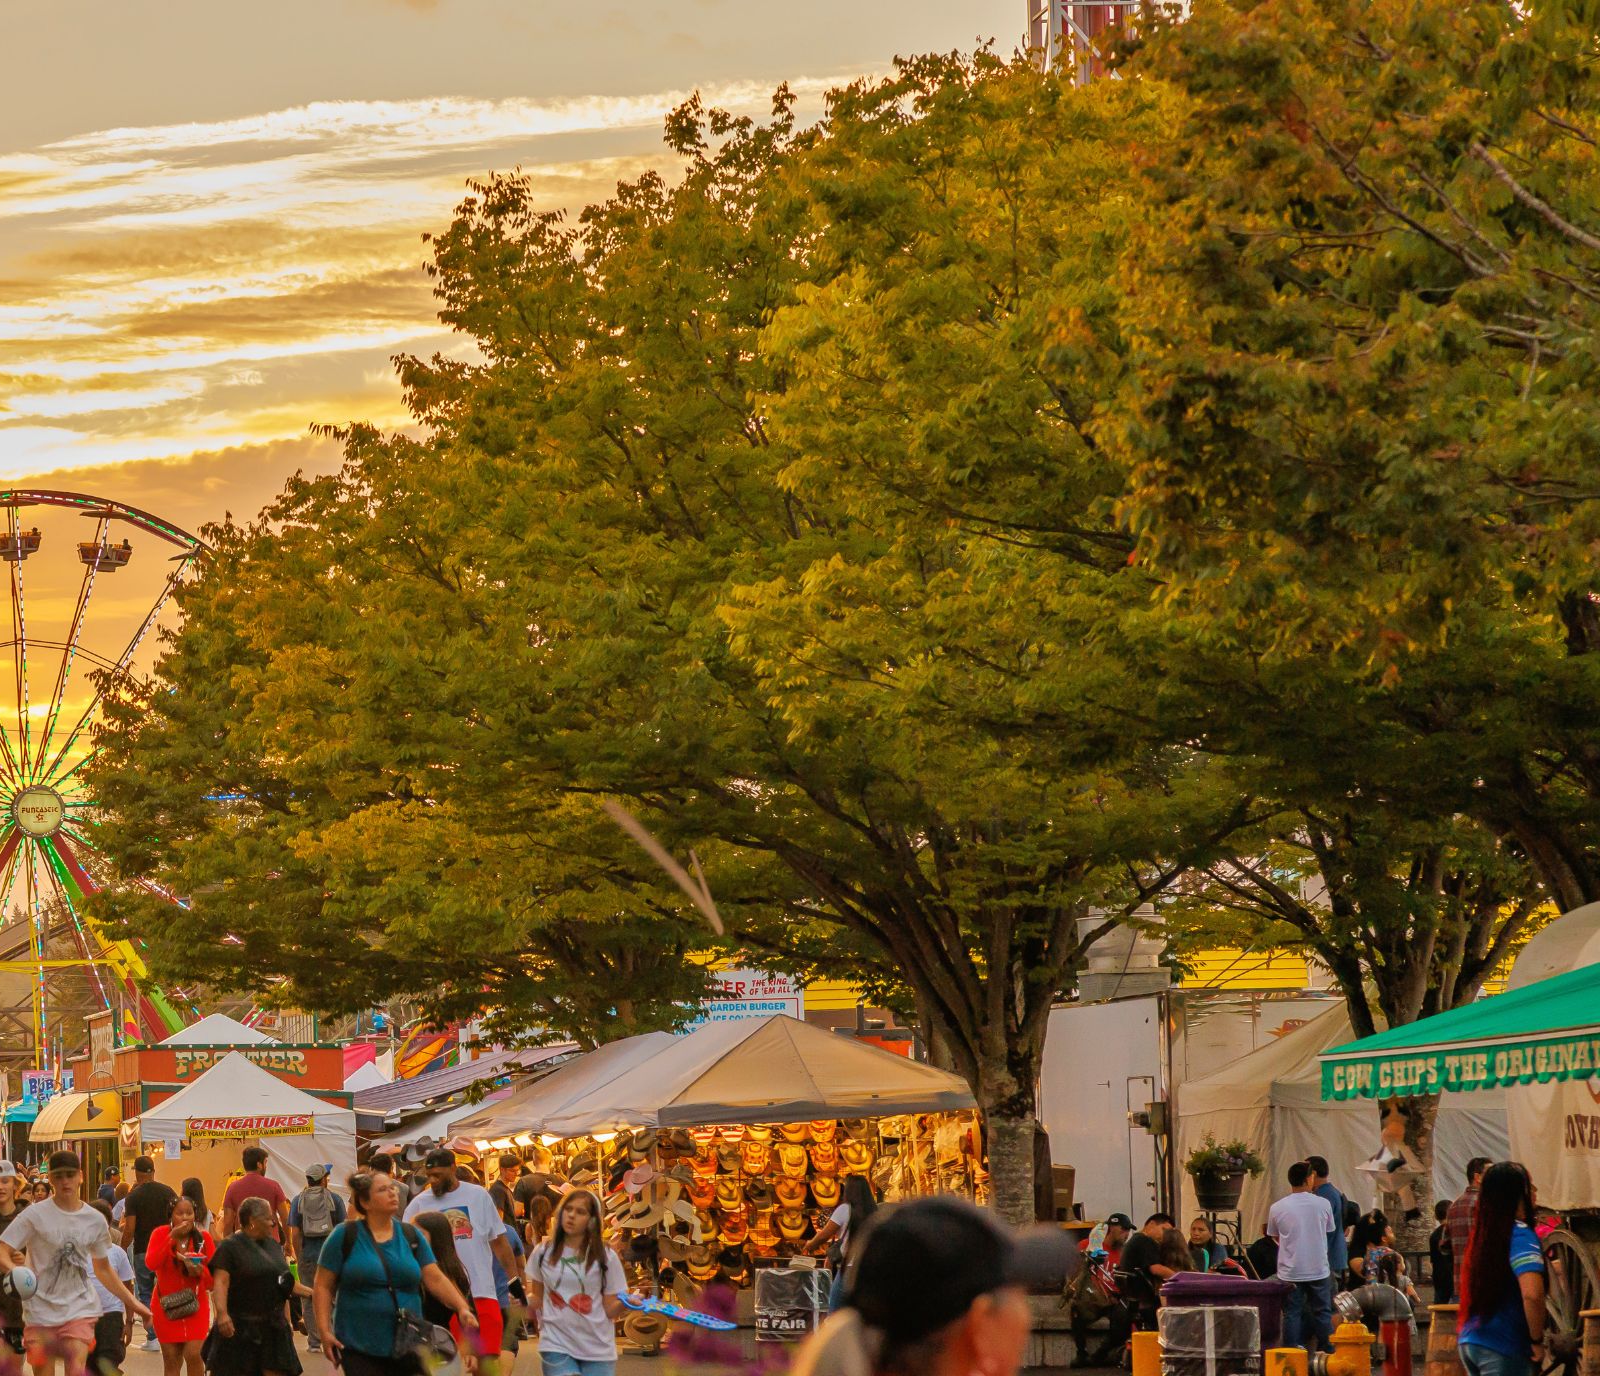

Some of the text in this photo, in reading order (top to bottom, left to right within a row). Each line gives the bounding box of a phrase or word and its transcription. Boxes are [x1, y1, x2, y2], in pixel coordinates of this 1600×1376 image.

[752, 979, 765, 987] THE
[749, 988, 759, 996] OF
[778, 985, 791, 994] ALL
[710, 1003, 747, 1012] GARDEN
[749, 1002, 786, 1011] BURGER
[175, 1051, 308, 1077] FRTIER
[1333, 1064, 1373, 1091] COW
[1379, 1058, 1437, 1088] CHIPS
[1445, 1053, 1488, 1083] THE
[188, 1115, 310, 1131] CARICATURES
[282, 1127, 311, 1135] MINUTES!
[771, 1319, 806, 1329] FAIR
